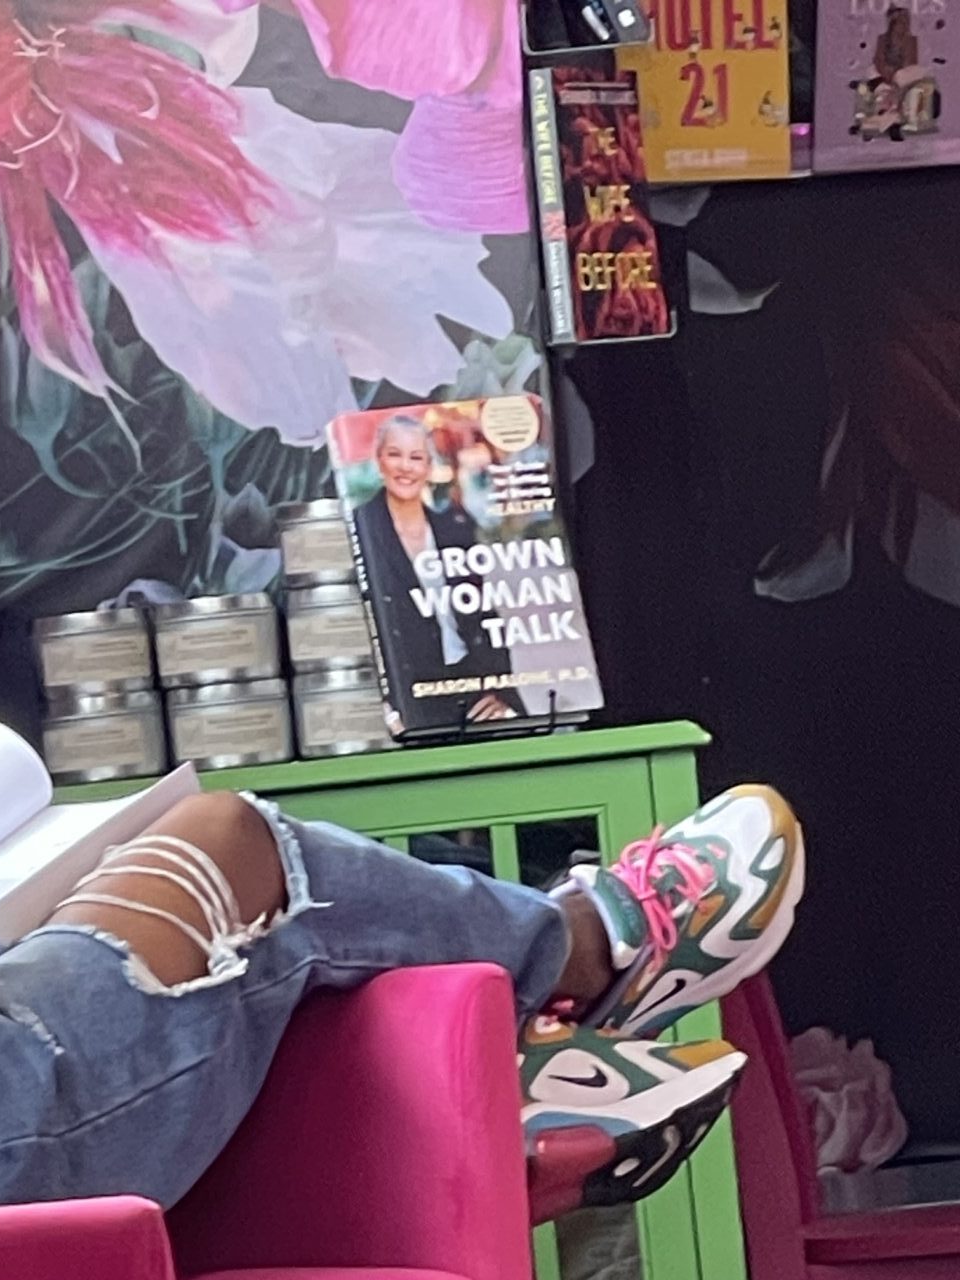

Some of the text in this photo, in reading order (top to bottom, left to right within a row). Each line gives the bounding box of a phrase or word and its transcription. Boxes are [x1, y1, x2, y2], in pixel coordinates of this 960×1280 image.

[679, 62, 728, 128] 21
[578, 252, 657, 291] BEFORE
[413, 536, 566, 580] GROWN
[408, 574, 573, 618] WOMAN
[481, 610, 582, 649] TALK
[412, 677, 482, 698] SHARON
